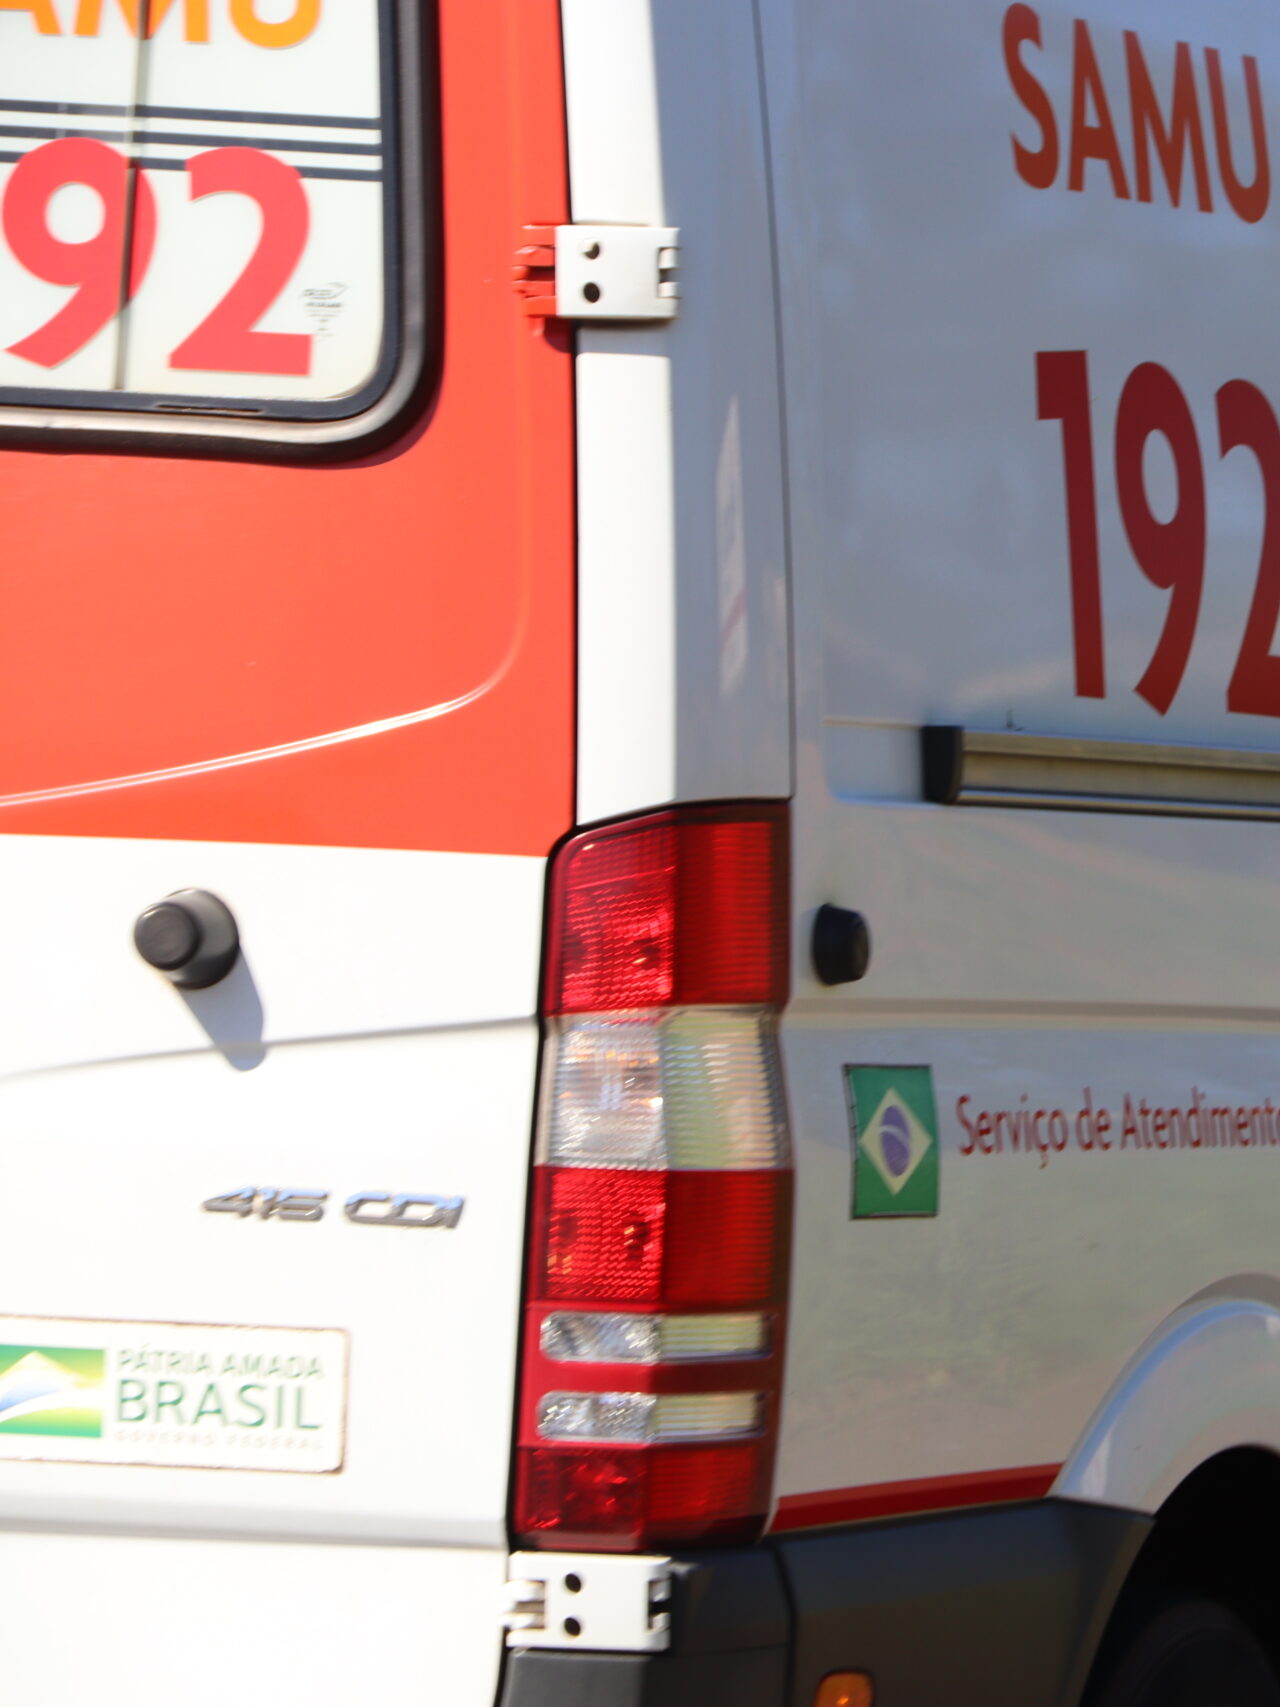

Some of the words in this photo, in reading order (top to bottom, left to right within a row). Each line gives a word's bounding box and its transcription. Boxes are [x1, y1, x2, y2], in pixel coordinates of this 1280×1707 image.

[1003, 2, 1271, 224] SAMU
[955, 1092, 1069, 1169] Serviço
[1075, 1087, 1114, 1152] de
[202, 1186, 330, 1221] 415
[344, 1189, 467, 1230] CDI
[116, 1343, 213, 1374] PÁTRIA
[219, 1352, 326, 1380] AMADA
[116, 1378, 324, 1431] BRASIL
